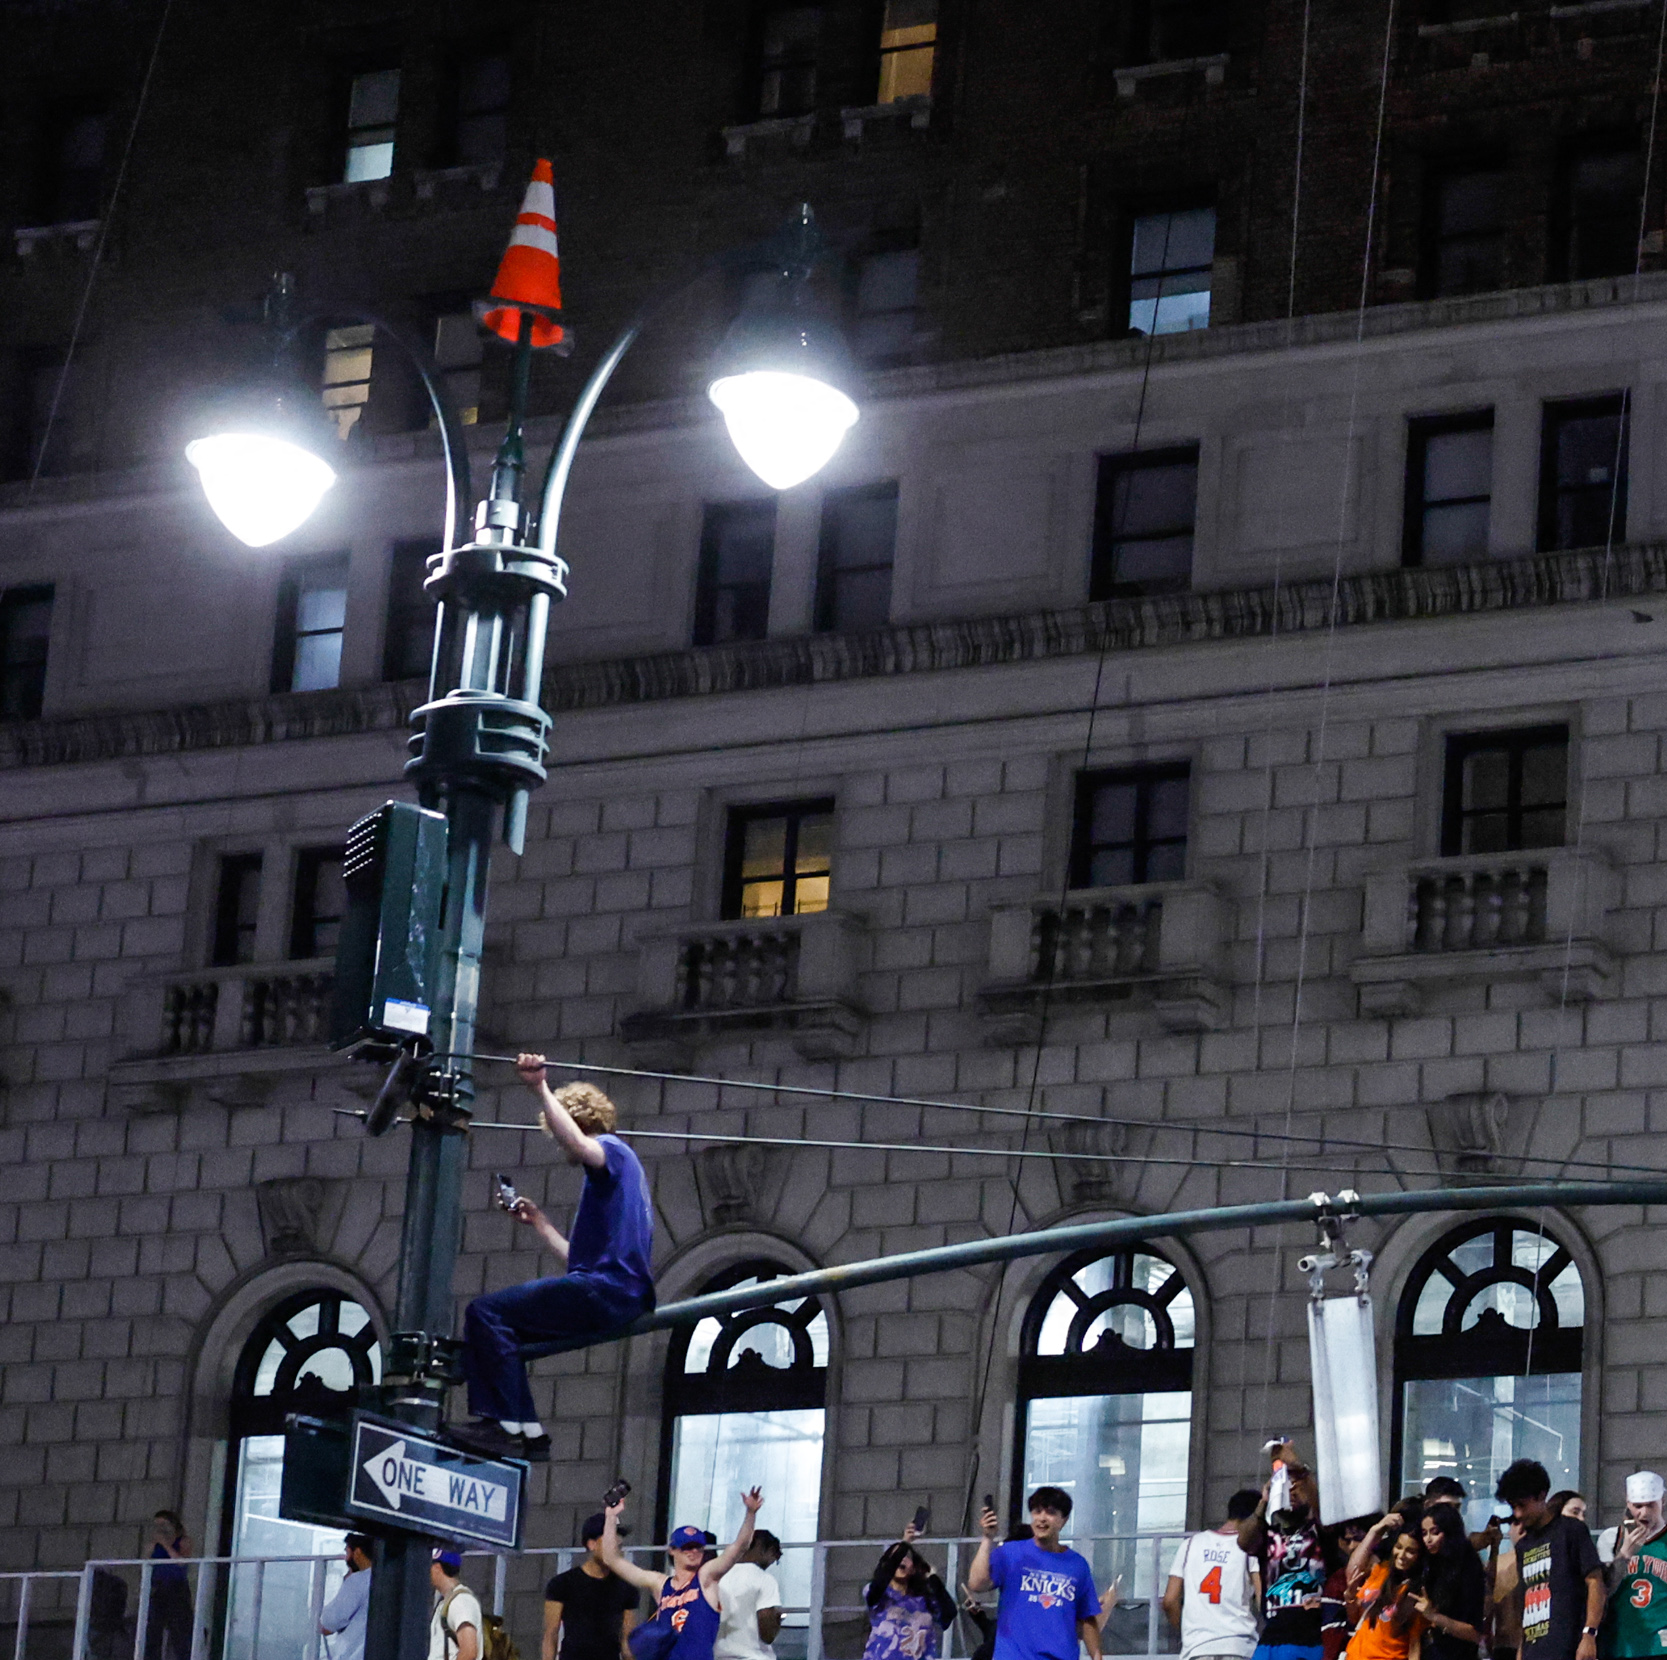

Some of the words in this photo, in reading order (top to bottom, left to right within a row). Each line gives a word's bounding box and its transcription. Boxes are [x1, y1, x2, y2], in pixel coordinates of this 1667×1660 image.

[381, 1457, 427, 1496] ONE
[449, 1475, 496, 1513] WAY
[1203, 1548, 1231, 1564] ROSE
[1019, 1574, 1076, 1602] KNICKS
[1199, 1565, 1223, 1605] 4
[1629, 1578, 1653, 1609] 3
